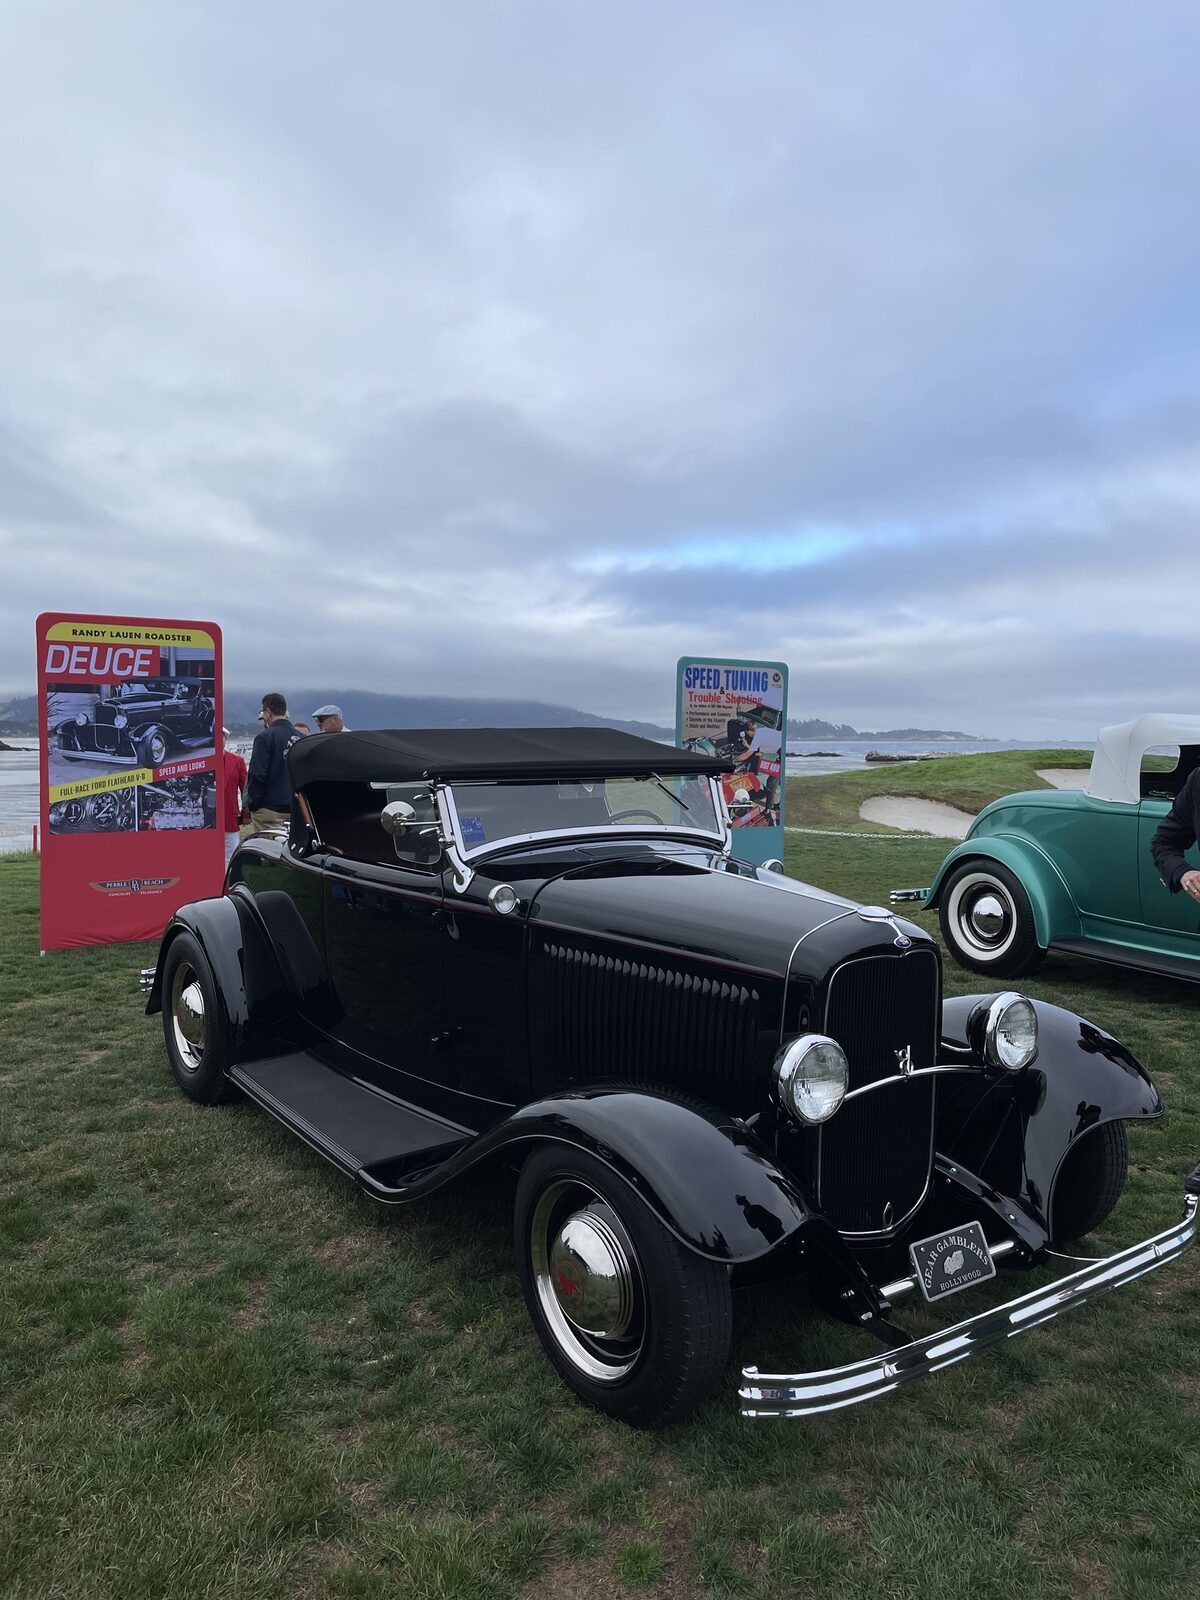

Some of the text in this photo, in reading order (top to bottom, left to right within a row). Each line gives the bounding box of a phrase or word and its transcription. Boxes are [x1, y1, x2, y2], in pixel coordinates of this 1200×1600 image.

[72, 629, 192, 642] RANDY LAUEN ROADSTER
[45, 644, 152, 677] DEUCE
[685, 667, 768, 692] SPEED TUNING
[720, 686, 725, 695] &
[688, 691, 763, 706] Trouble Shooting
[159, 761, 206, 776] SPEED AND LOOKS
[60, 772, 145, 796] FULL-RACE FORD FLATHEAD V-8
[924, 1236, 989, 1288] GEAR GAMBLERS
[940, 1269, 981, 1291] HOLLYWOOD
